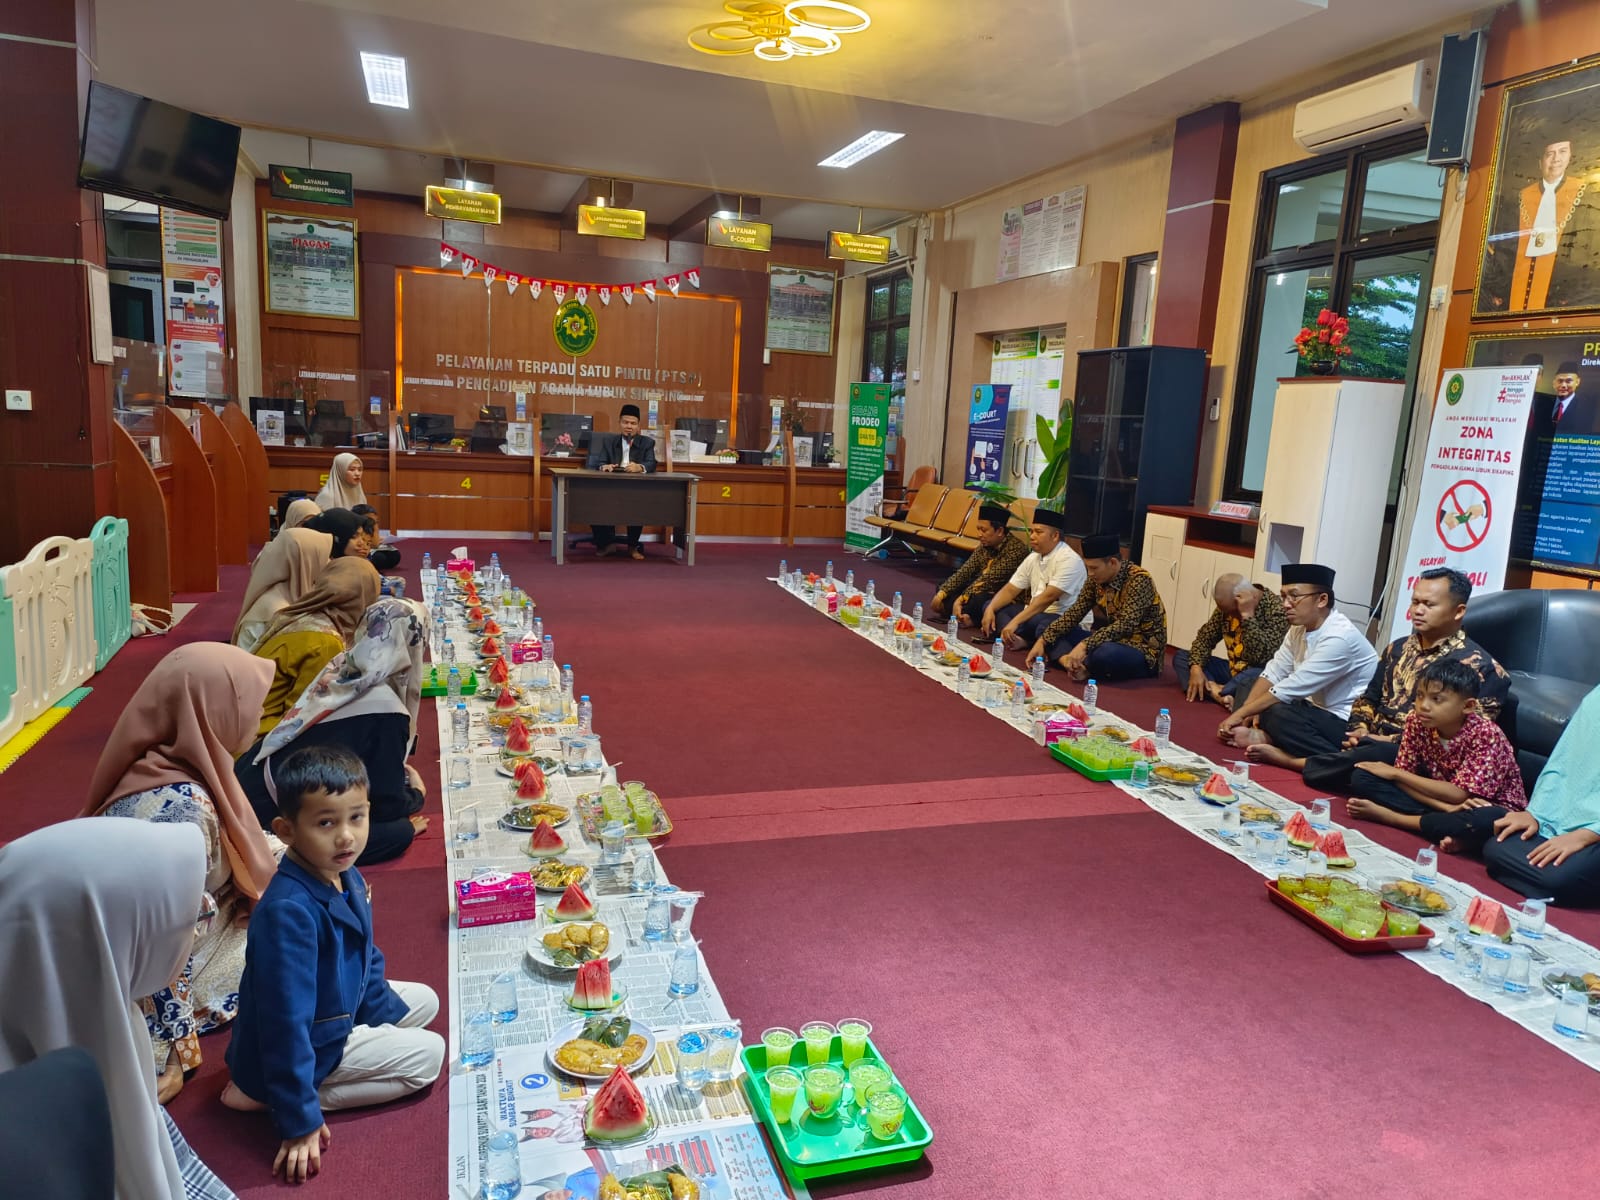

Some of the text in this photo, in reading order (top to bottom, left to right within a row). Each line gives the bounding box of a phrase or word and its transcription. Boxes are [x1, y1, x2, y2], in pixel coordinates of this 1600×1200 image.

[729, 226, 757, 235] LAYANAN
[292, 238, 331, 249] PIAGAM
[730, 235, 756, 244] E-COURT
[436, 354, 513, 371] PELAYANAN
[517, 359, 575, 376] TERPADU
[580, 364, 611, 378] SATU
[615, 366, 651, 381] PINTU
[852, 416, 880, 427] PRODEO
[1460, 426, 1493, 439] ZONA
[1438, 446, 1511, 463] INTEGRITAS
[461, 477, 471, 489] 4
[722, 487, 731, 498] 2
[525, 1074, 545, 1085] 2
[456, 1155, 466, 1180] IKLAN
